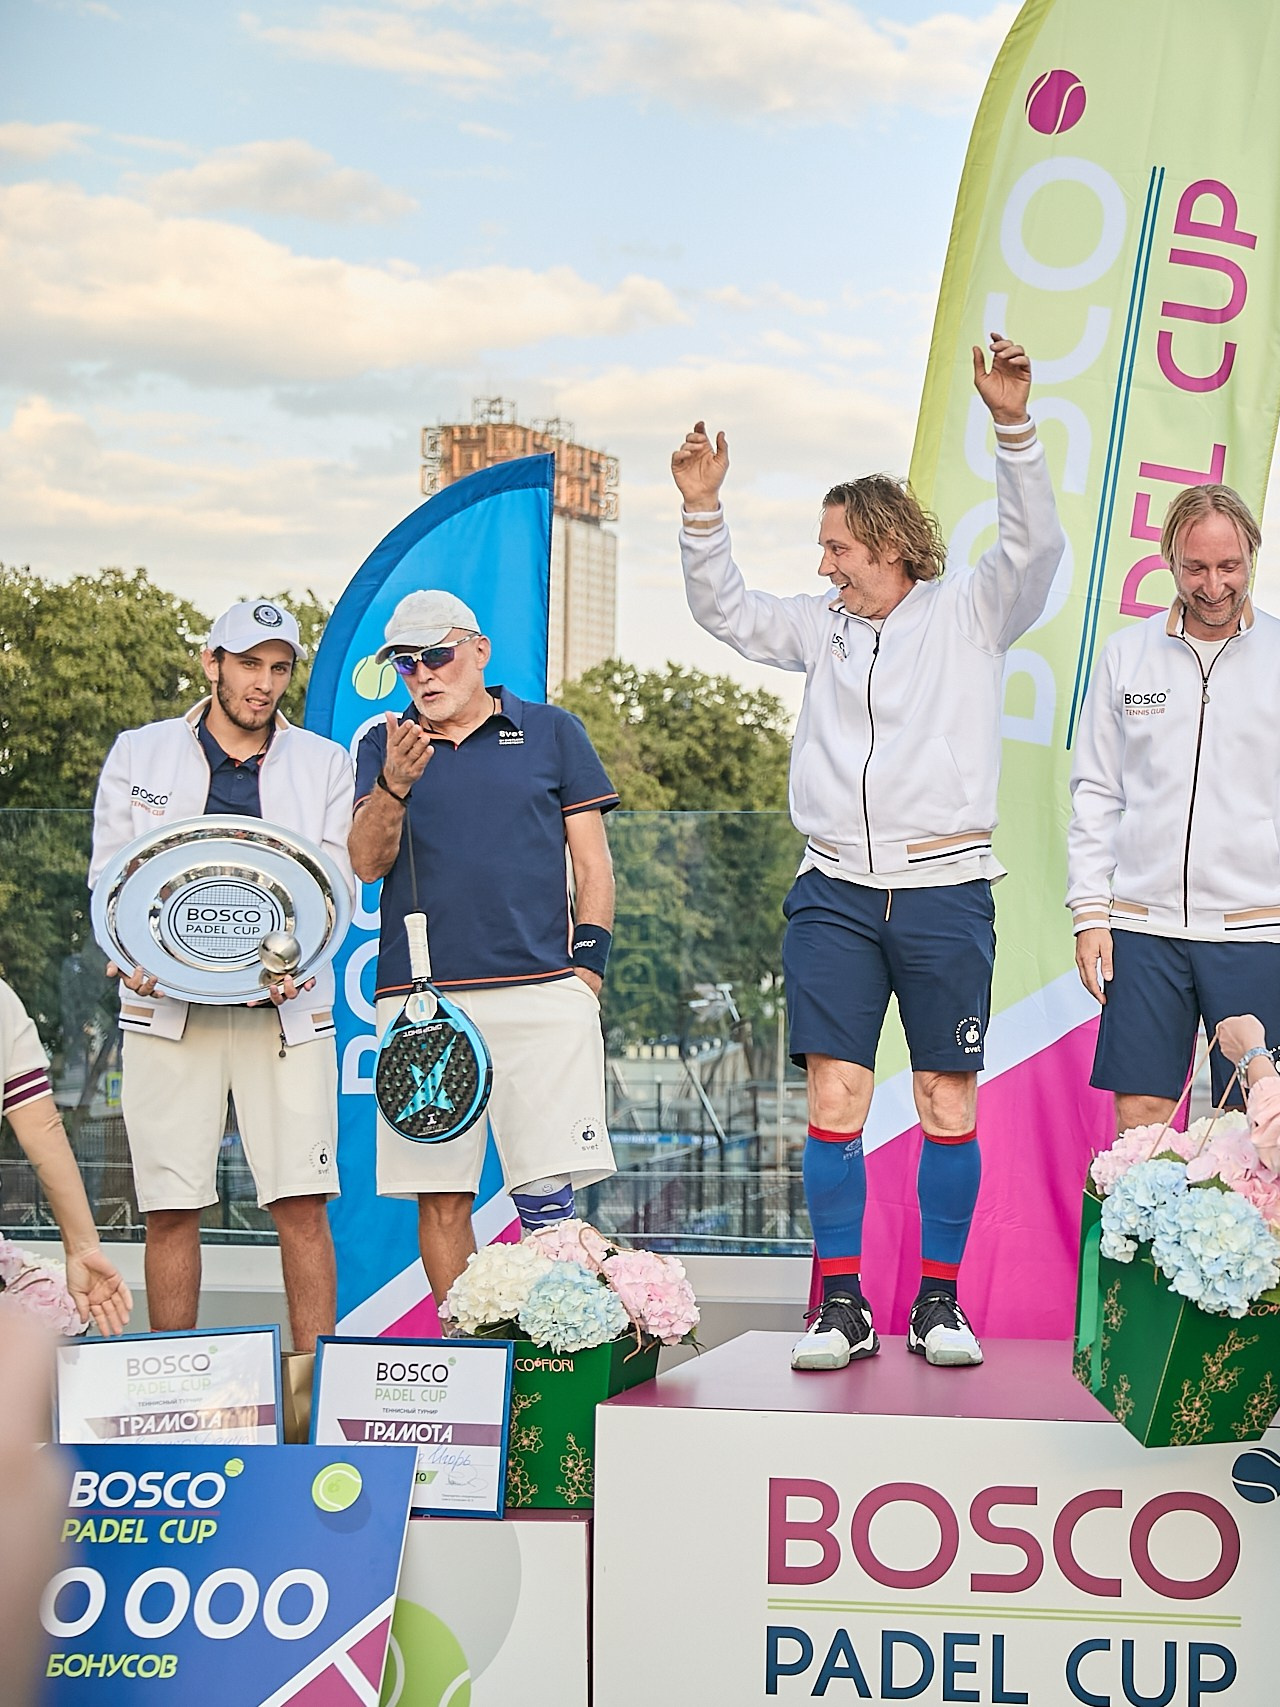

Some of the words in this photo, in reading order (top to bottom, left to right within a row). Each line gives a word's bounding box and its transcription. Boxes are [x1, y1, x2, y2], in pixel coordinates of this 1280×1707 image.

[1155, 178, 1258, 394] CUP
[1124, 692, 1167, 705] BOSCO
[1126, 708, 1150, 716] TENNIS
[131, 785, 169, 806] BOSCO
[187, 907, 262, 924] BOSCO
[185, 923, 228, 935] PADEL
[233, 925, 261, 936] CUP
[126, 1353, 211, 1378] BOSCO
[375, 1362, 449, 1383] BOSCO
[127, 1378, 175, 1396] PADEL
[181, 1376, 212, 1393] CUP
[375, 1387, 416, 1402] PADEL
[420, 1389, 448, 1403] CUP
[382, 1407, 417, 1415] ТЕННИСНЫЙ
[118, 1411, 222, 1436] ГРАМОТА
[363, 1420, 453, 1443] ГРАМОТА
[68, 1470, 227, 1510] BOSCO
[60, 1518, 150, 1545] PADEL
[159, 1519, 218, 1545] CUP
[766, 1476, 1242, 1601] BOSCO
[124, 1566, 330, 1640] 000
[45, 1652, 179, 1679] БОНУСОВ
[764, 1625, 1029, 1706] PADEL
[1064, 1637, 1238, 1707] CUP
